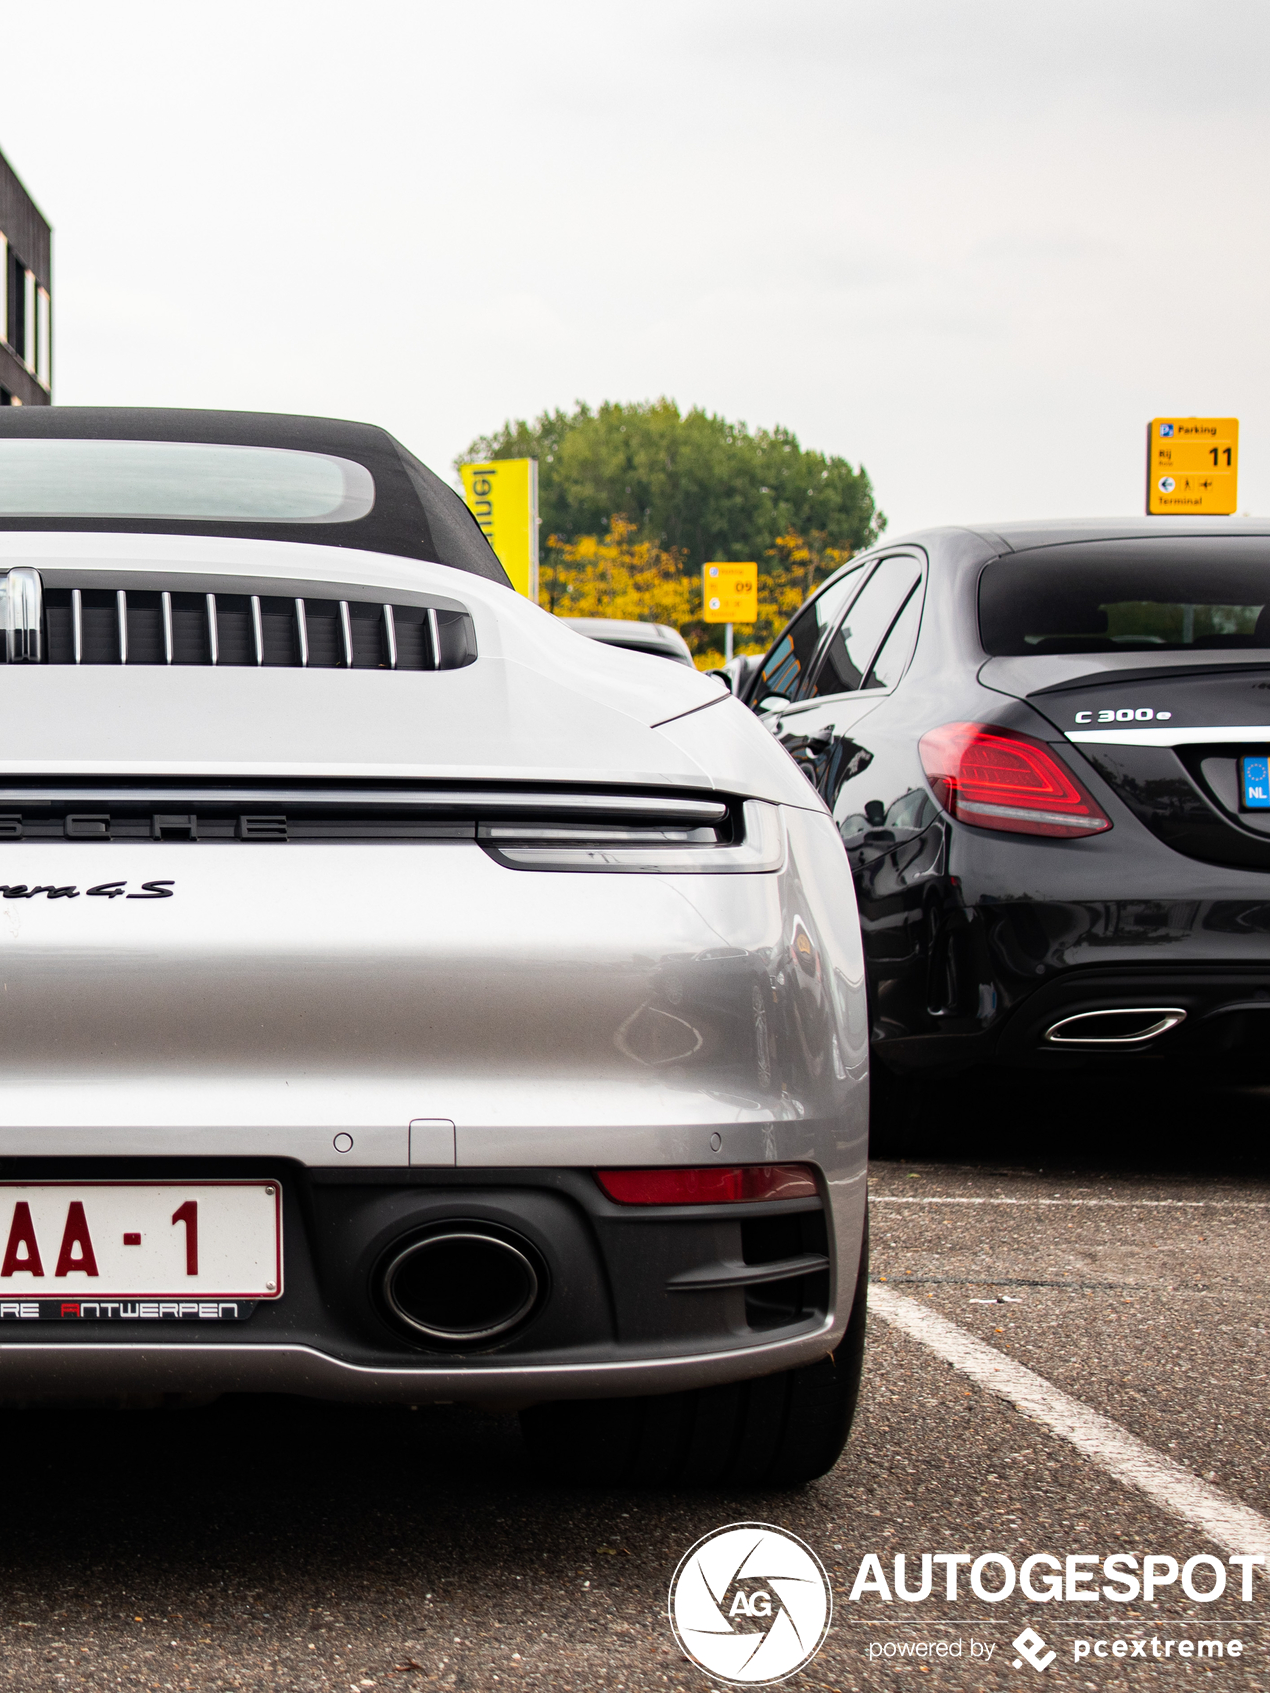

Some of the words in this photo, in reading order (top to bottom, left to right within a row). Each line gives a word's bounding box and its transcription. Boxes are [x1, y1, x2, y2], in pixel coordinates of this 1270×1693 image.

[1178, 425, 1217, 436] Parking
[1209, 447, 1232, 466] 11
[1159, 496, 1203, 506] Terminal
[735, 581, 753, 594] 09
[1075, 711, 1092, 723] C
[1248, 787, 1267, 799] NL
[61, 1303, 238, 1318] ANTWERPEN
